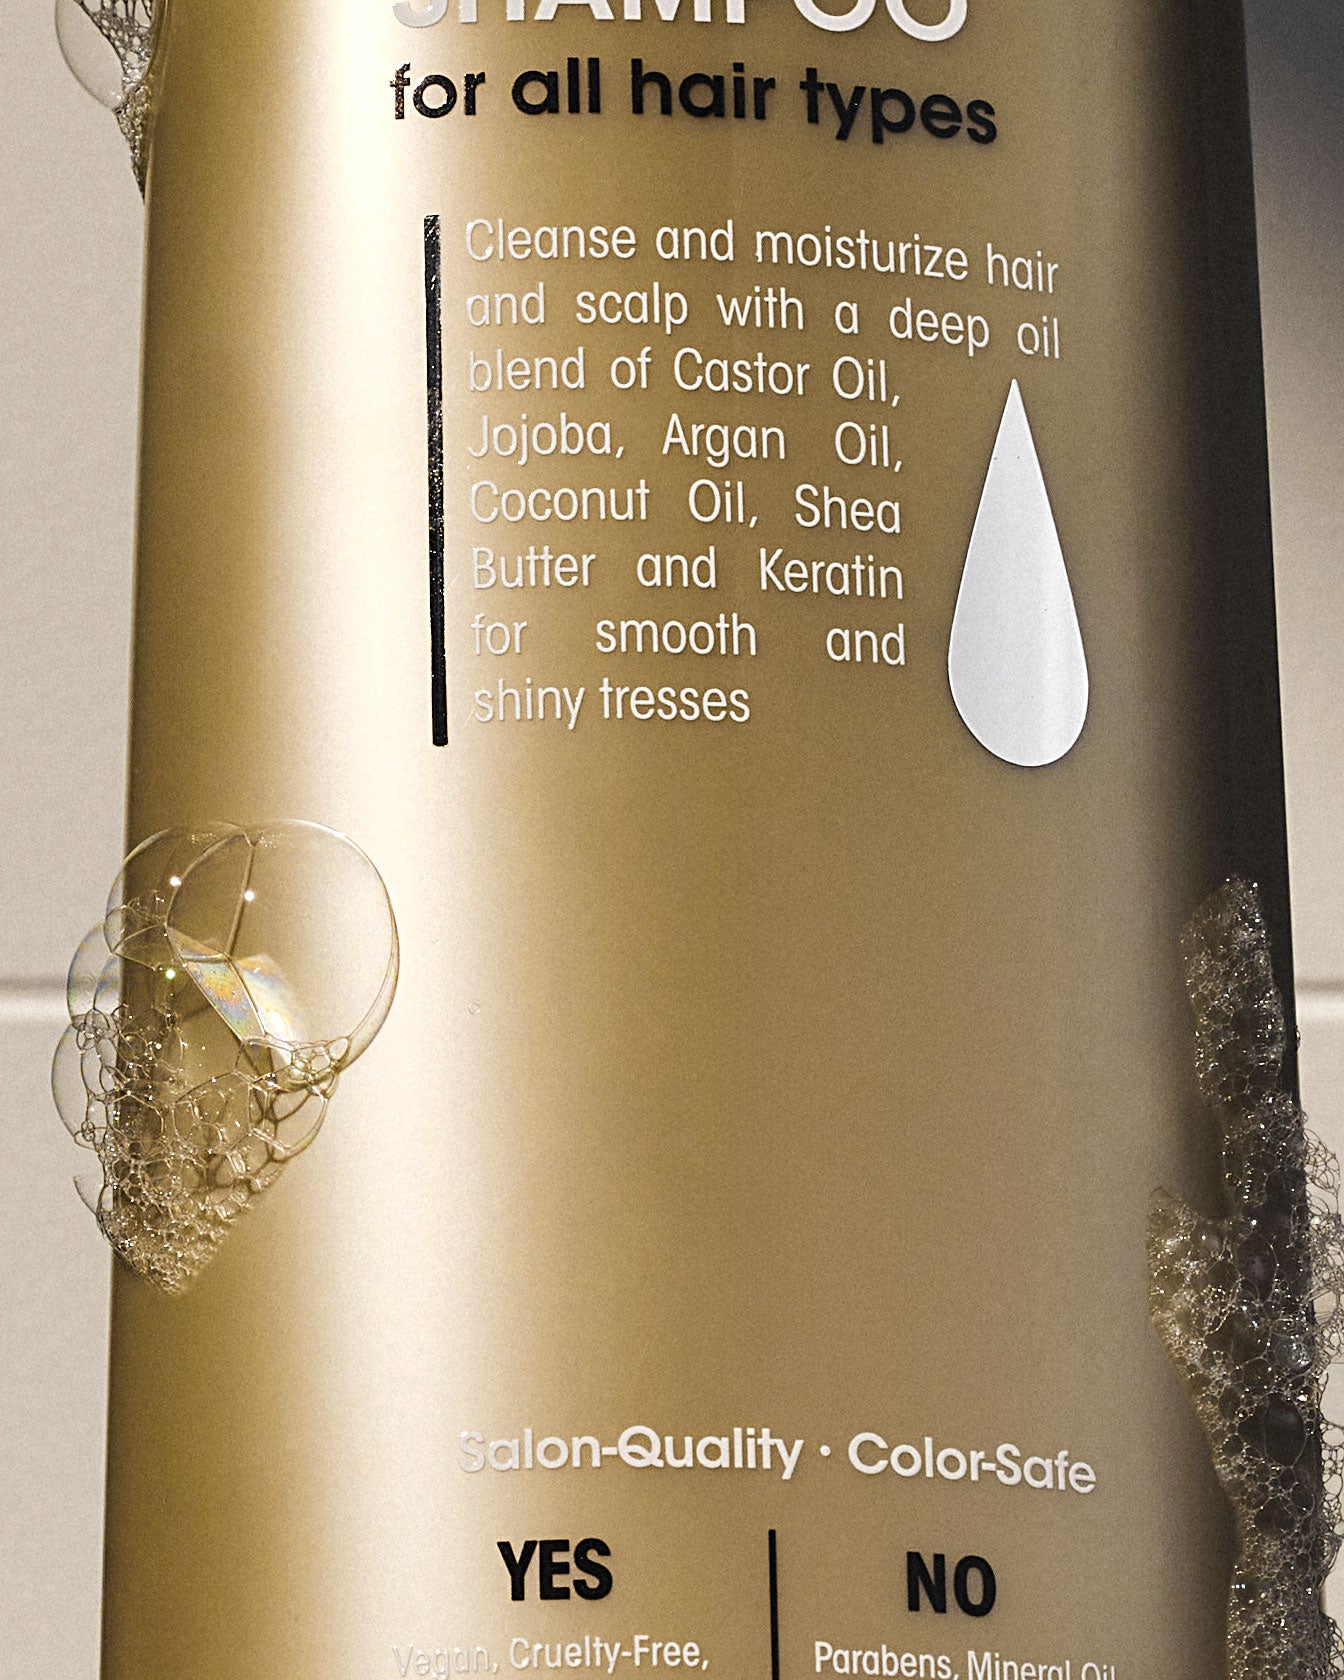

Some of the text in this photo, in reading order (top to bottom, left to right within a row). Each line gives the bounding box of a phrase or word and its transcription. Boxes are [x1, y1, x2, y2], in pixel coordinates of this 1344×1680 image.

[390, 58, 998, 145] for all hair types
[464, 219, 1059, 294] Cleanse and moisturize hair
[466, 282, 1060, 359] and scalp with a deep oil
[469, 346, 901, 408] blend of Castor Oil,
[466, 413, 903, 472] Jojoba, Argan Oil,
[470, 479, 902, 534] Coconut Oil, Shea
[471, 546, 904, 599] Butter and Keratin
[471, 613, 906, 666] for smooth and
[473, 678, 751, 730] shiny tresses
[458, 1425, 1097, 1494] Salon-Quality Color-Safe
[496, 1538, 613, 1601] YES
[906, 1551, 996, 1617] NO
[391, 1634, 709, 1680] Vegan, Cruelty-Free,
